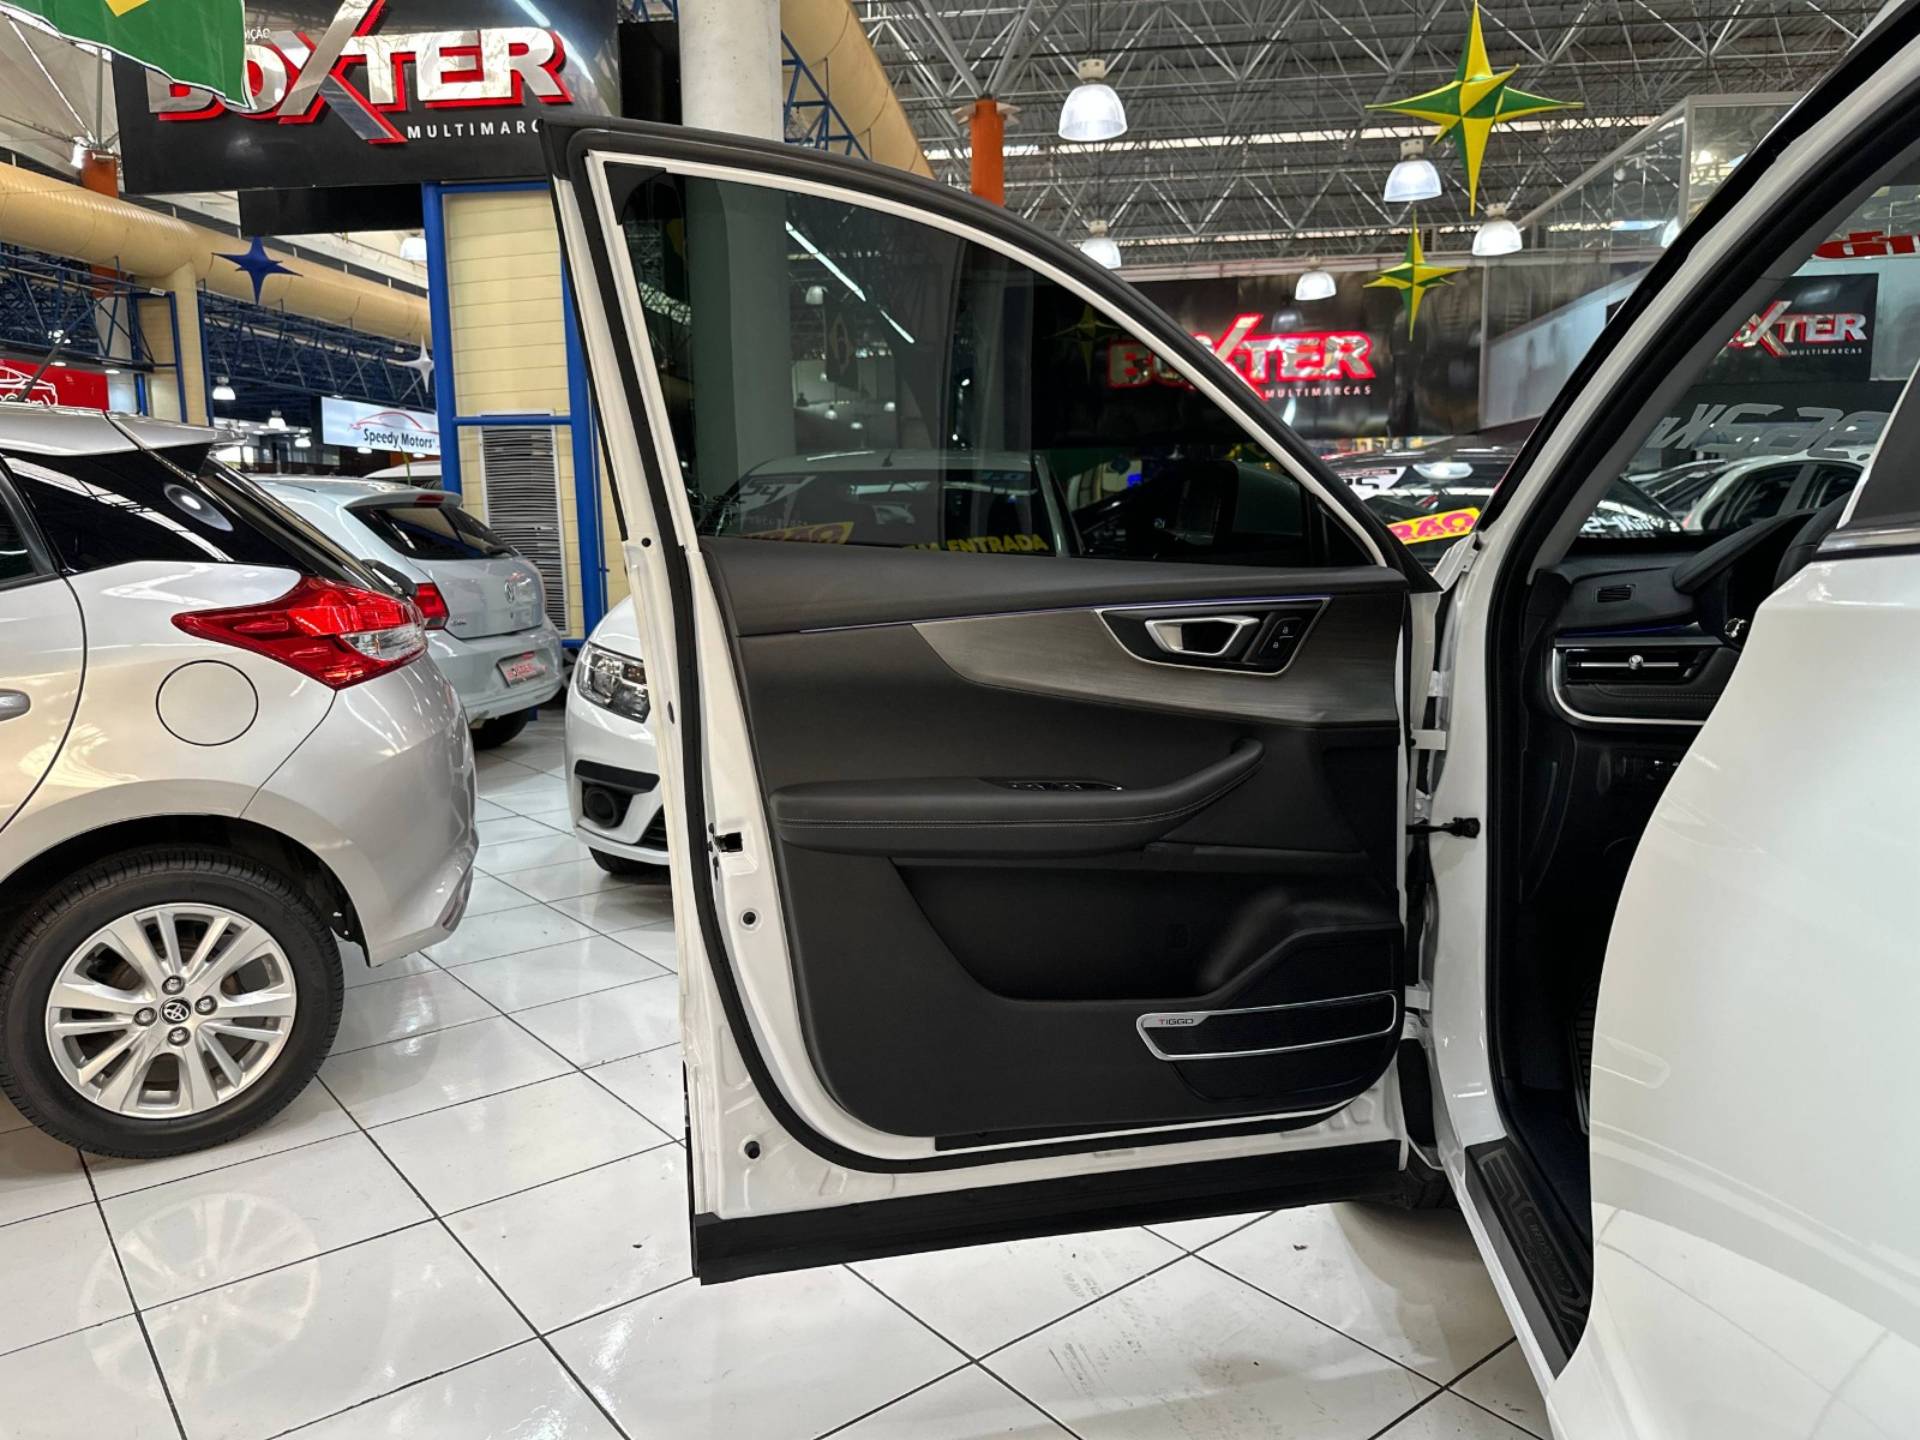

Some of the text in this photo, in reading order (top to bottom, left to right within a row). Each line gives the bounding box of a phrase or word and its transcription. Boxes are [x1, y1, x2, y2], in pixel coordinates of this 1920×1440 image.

[1264, 385, 1372, 398] MULTIMARCAS
[363, 427, 433, 449] Speedy Motors
[946, 533, 1050, 554] ENTRADA
[1157, 1018, 1194, 1026] TIGGO
